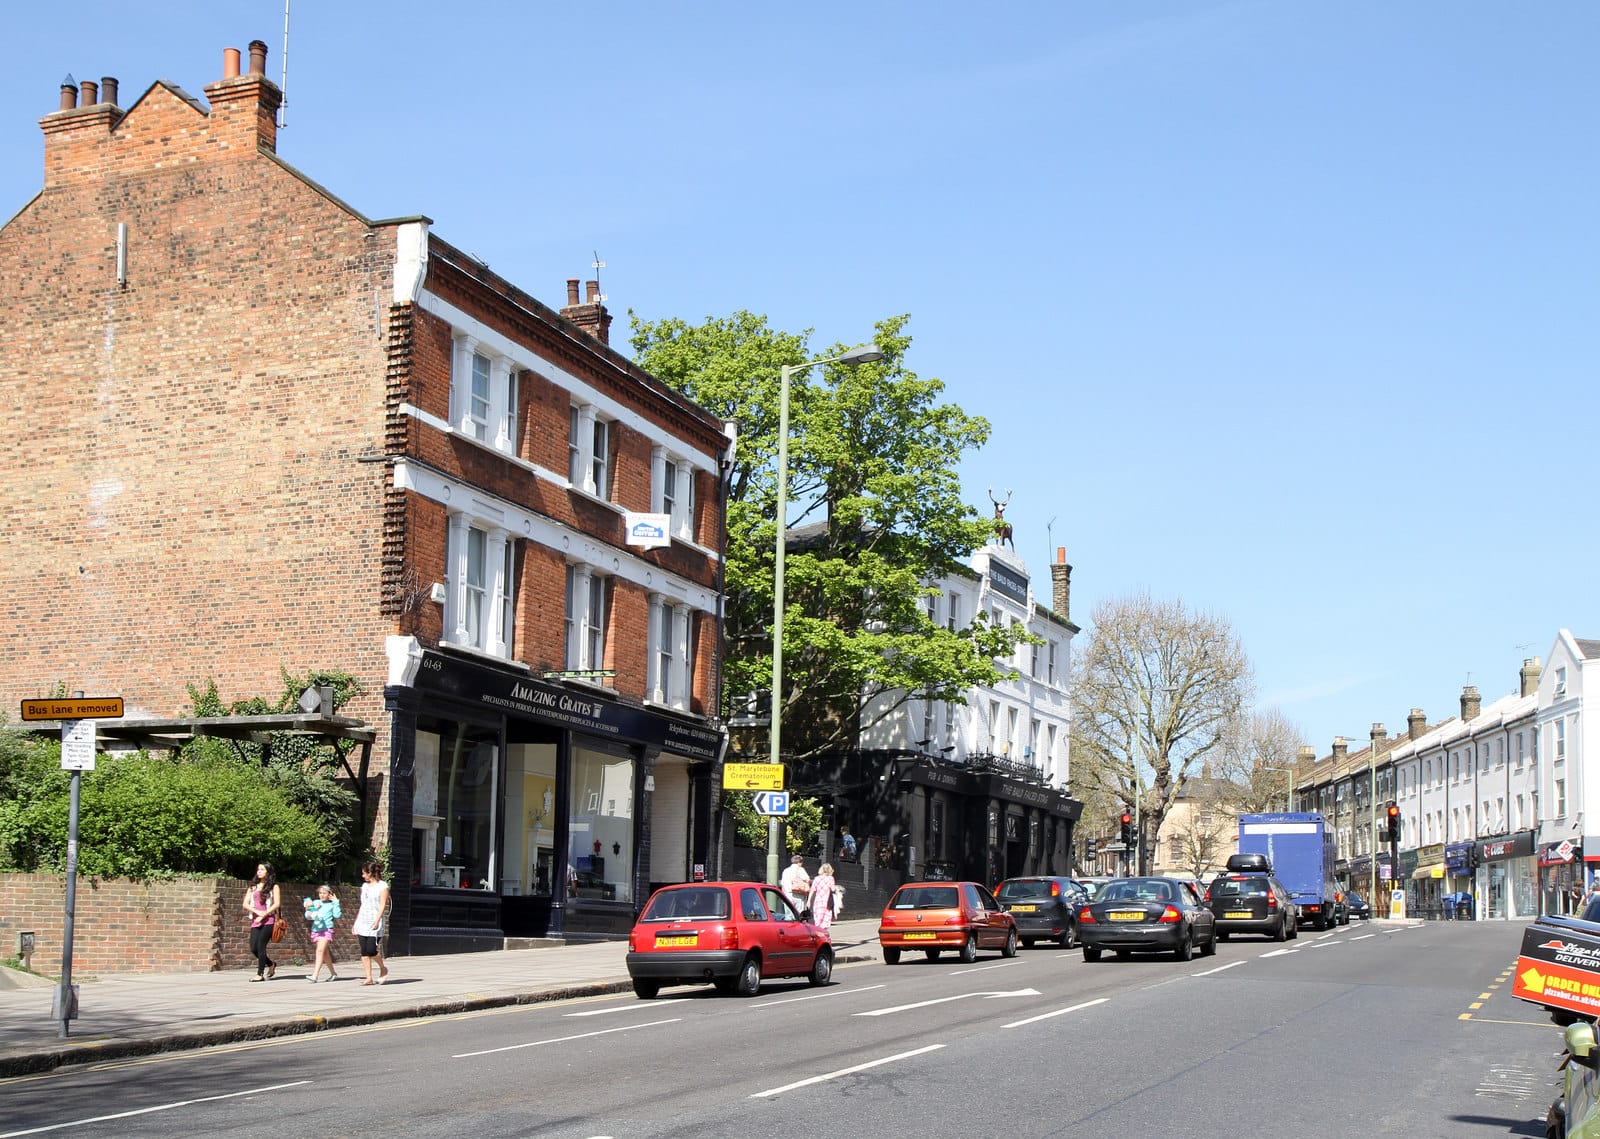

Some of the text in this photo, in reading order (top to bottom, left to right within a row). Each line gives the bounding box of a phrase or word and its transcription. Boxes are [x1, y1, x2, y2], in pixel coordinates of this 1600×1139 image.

[424, 658, 442, 672] 61-63
[510, 682, 592, 716] AMAZING GRATES
[28, 703, 118, 715] Bus lane removed
[481, 694, 509, 707] SPECIALISTS
[509, 701, 515, 709] IN
[515, 702, 533, 713] PERIOD
[536, 708, 570, 722] CONTEMPORARY
[772, 796, 784, 811] P
[1565, 942, 1591, 954] Pizza
[1555, 954, 1600, 967] DELIVERY
[1546, 975, 1581, 993] ORDER
